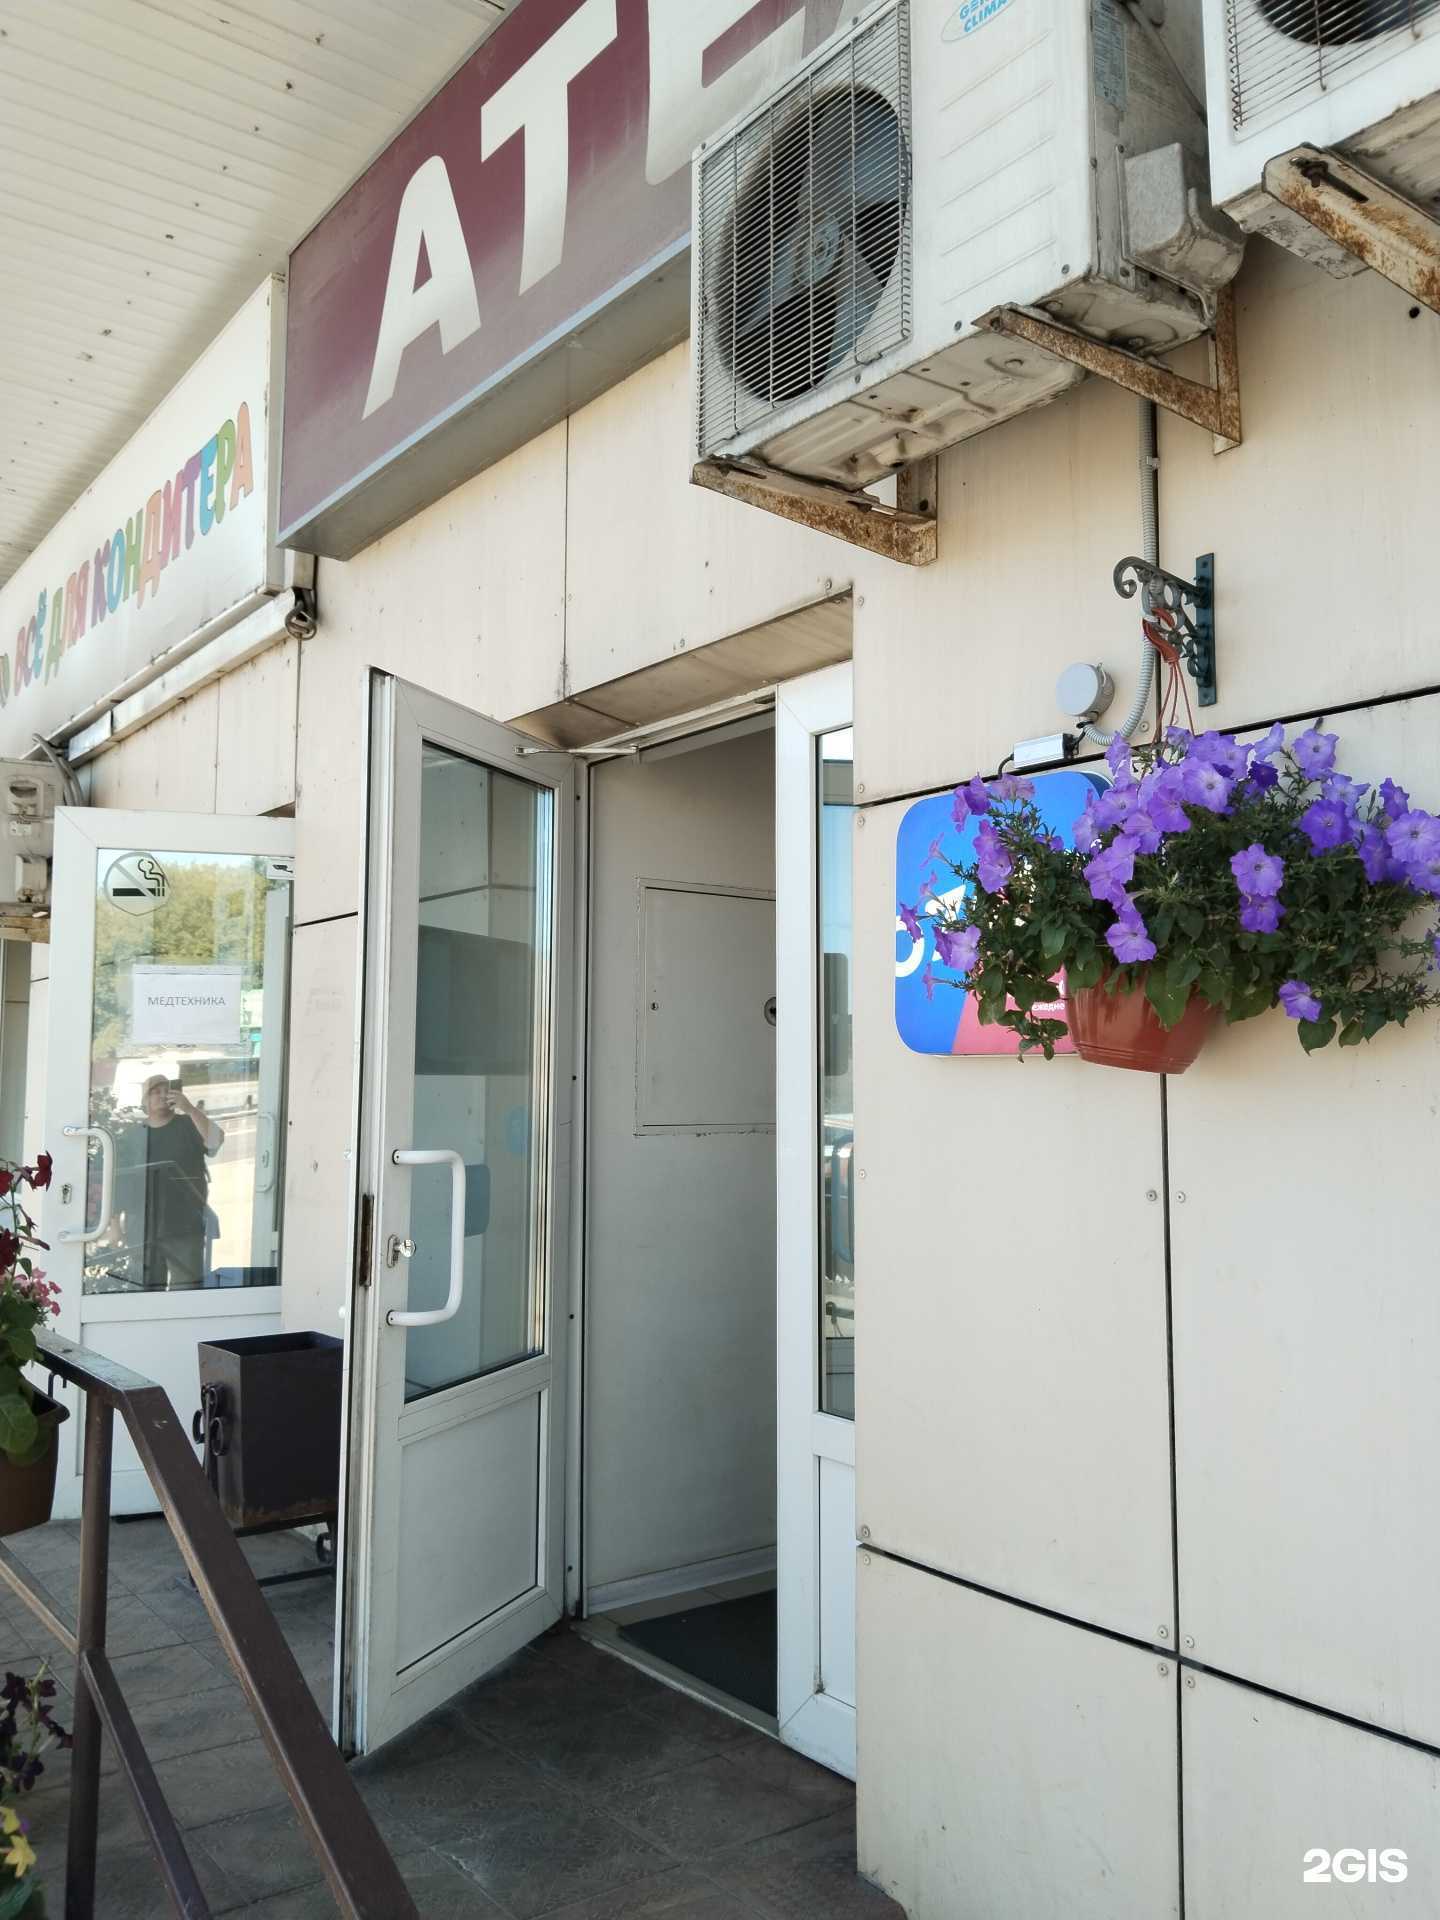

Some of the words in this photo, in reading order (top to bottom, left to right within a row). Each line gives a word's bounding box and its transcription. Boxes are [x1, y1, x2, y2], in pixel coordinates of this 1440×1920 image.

[362, 0, 882, 421] АТЕ
[91, 401, 254, 628] КОНДИТЕРА
[147, 996, 226, 1007] МЕДТЕХНИКА
